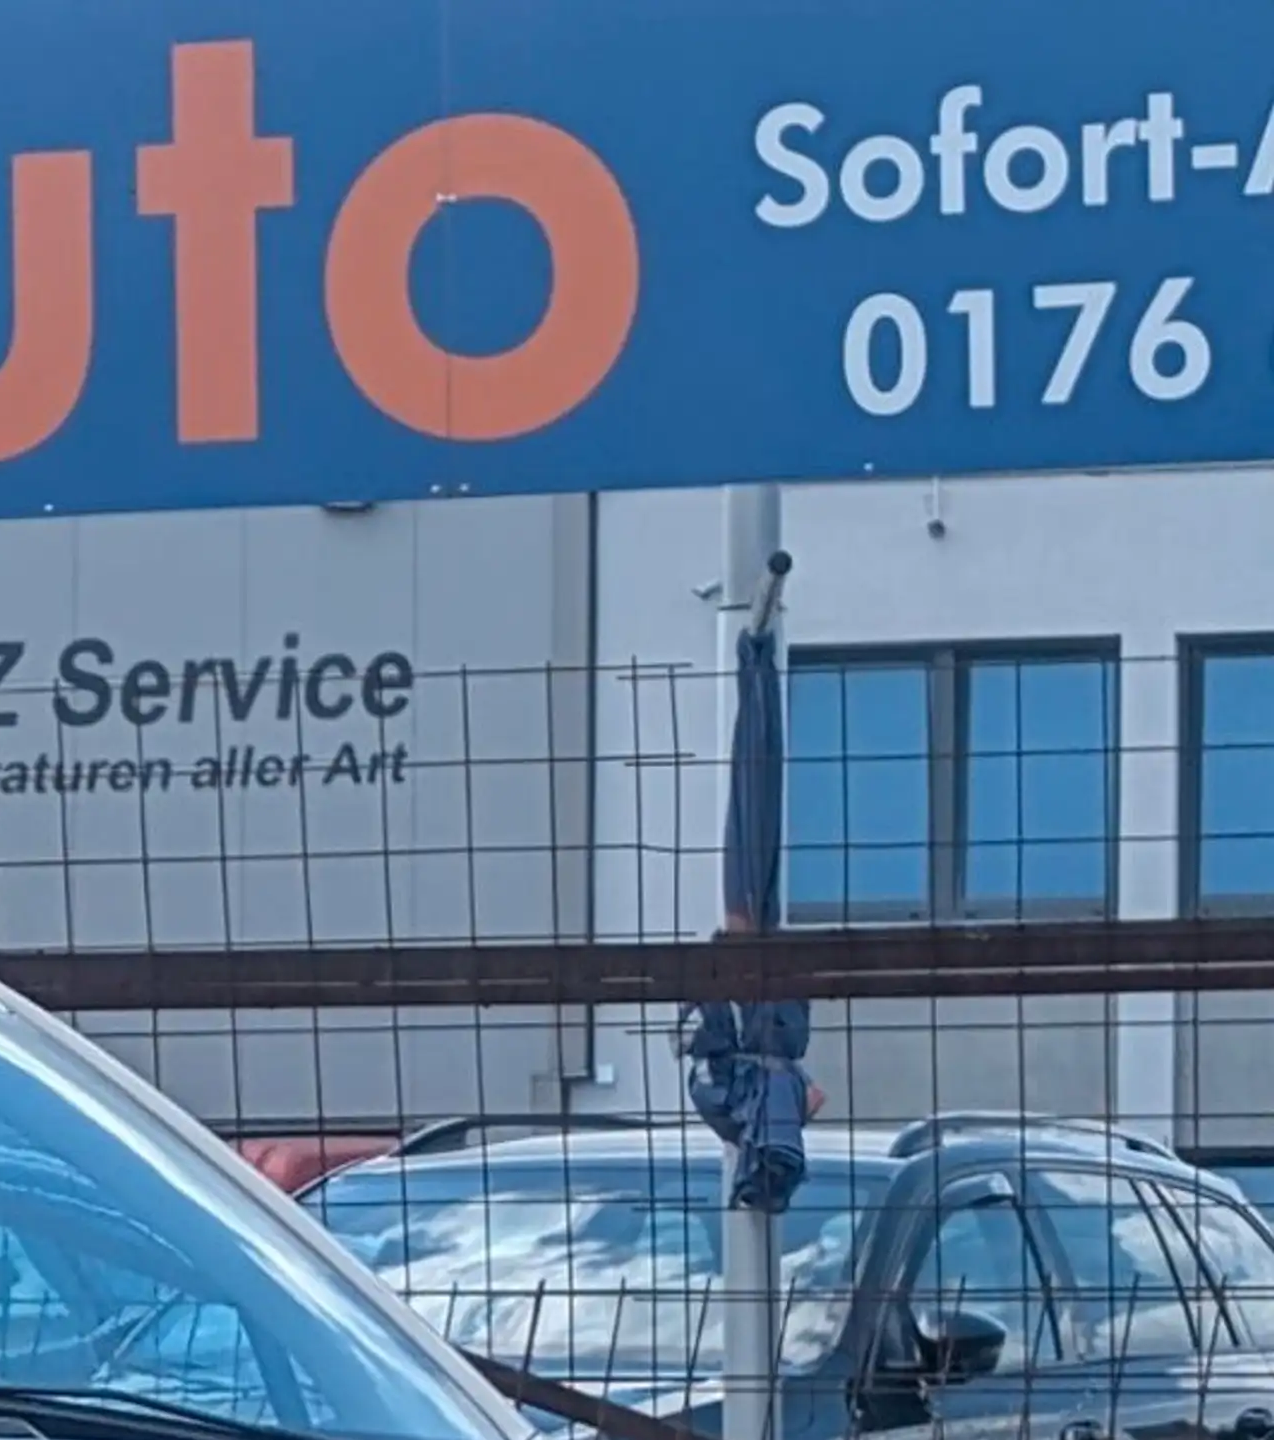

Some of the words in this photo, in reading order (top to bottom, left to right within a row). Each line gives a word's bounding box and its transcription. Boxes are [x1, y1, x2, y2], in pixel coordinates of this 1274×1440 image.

[754, 85, 1274, 228] Sofort-
[842, 276, 1211, 416] 0176
[53, 633, 414, 727] Service
[189, 745, 311, 789] aller
[323, 742, 408, 786] Art
